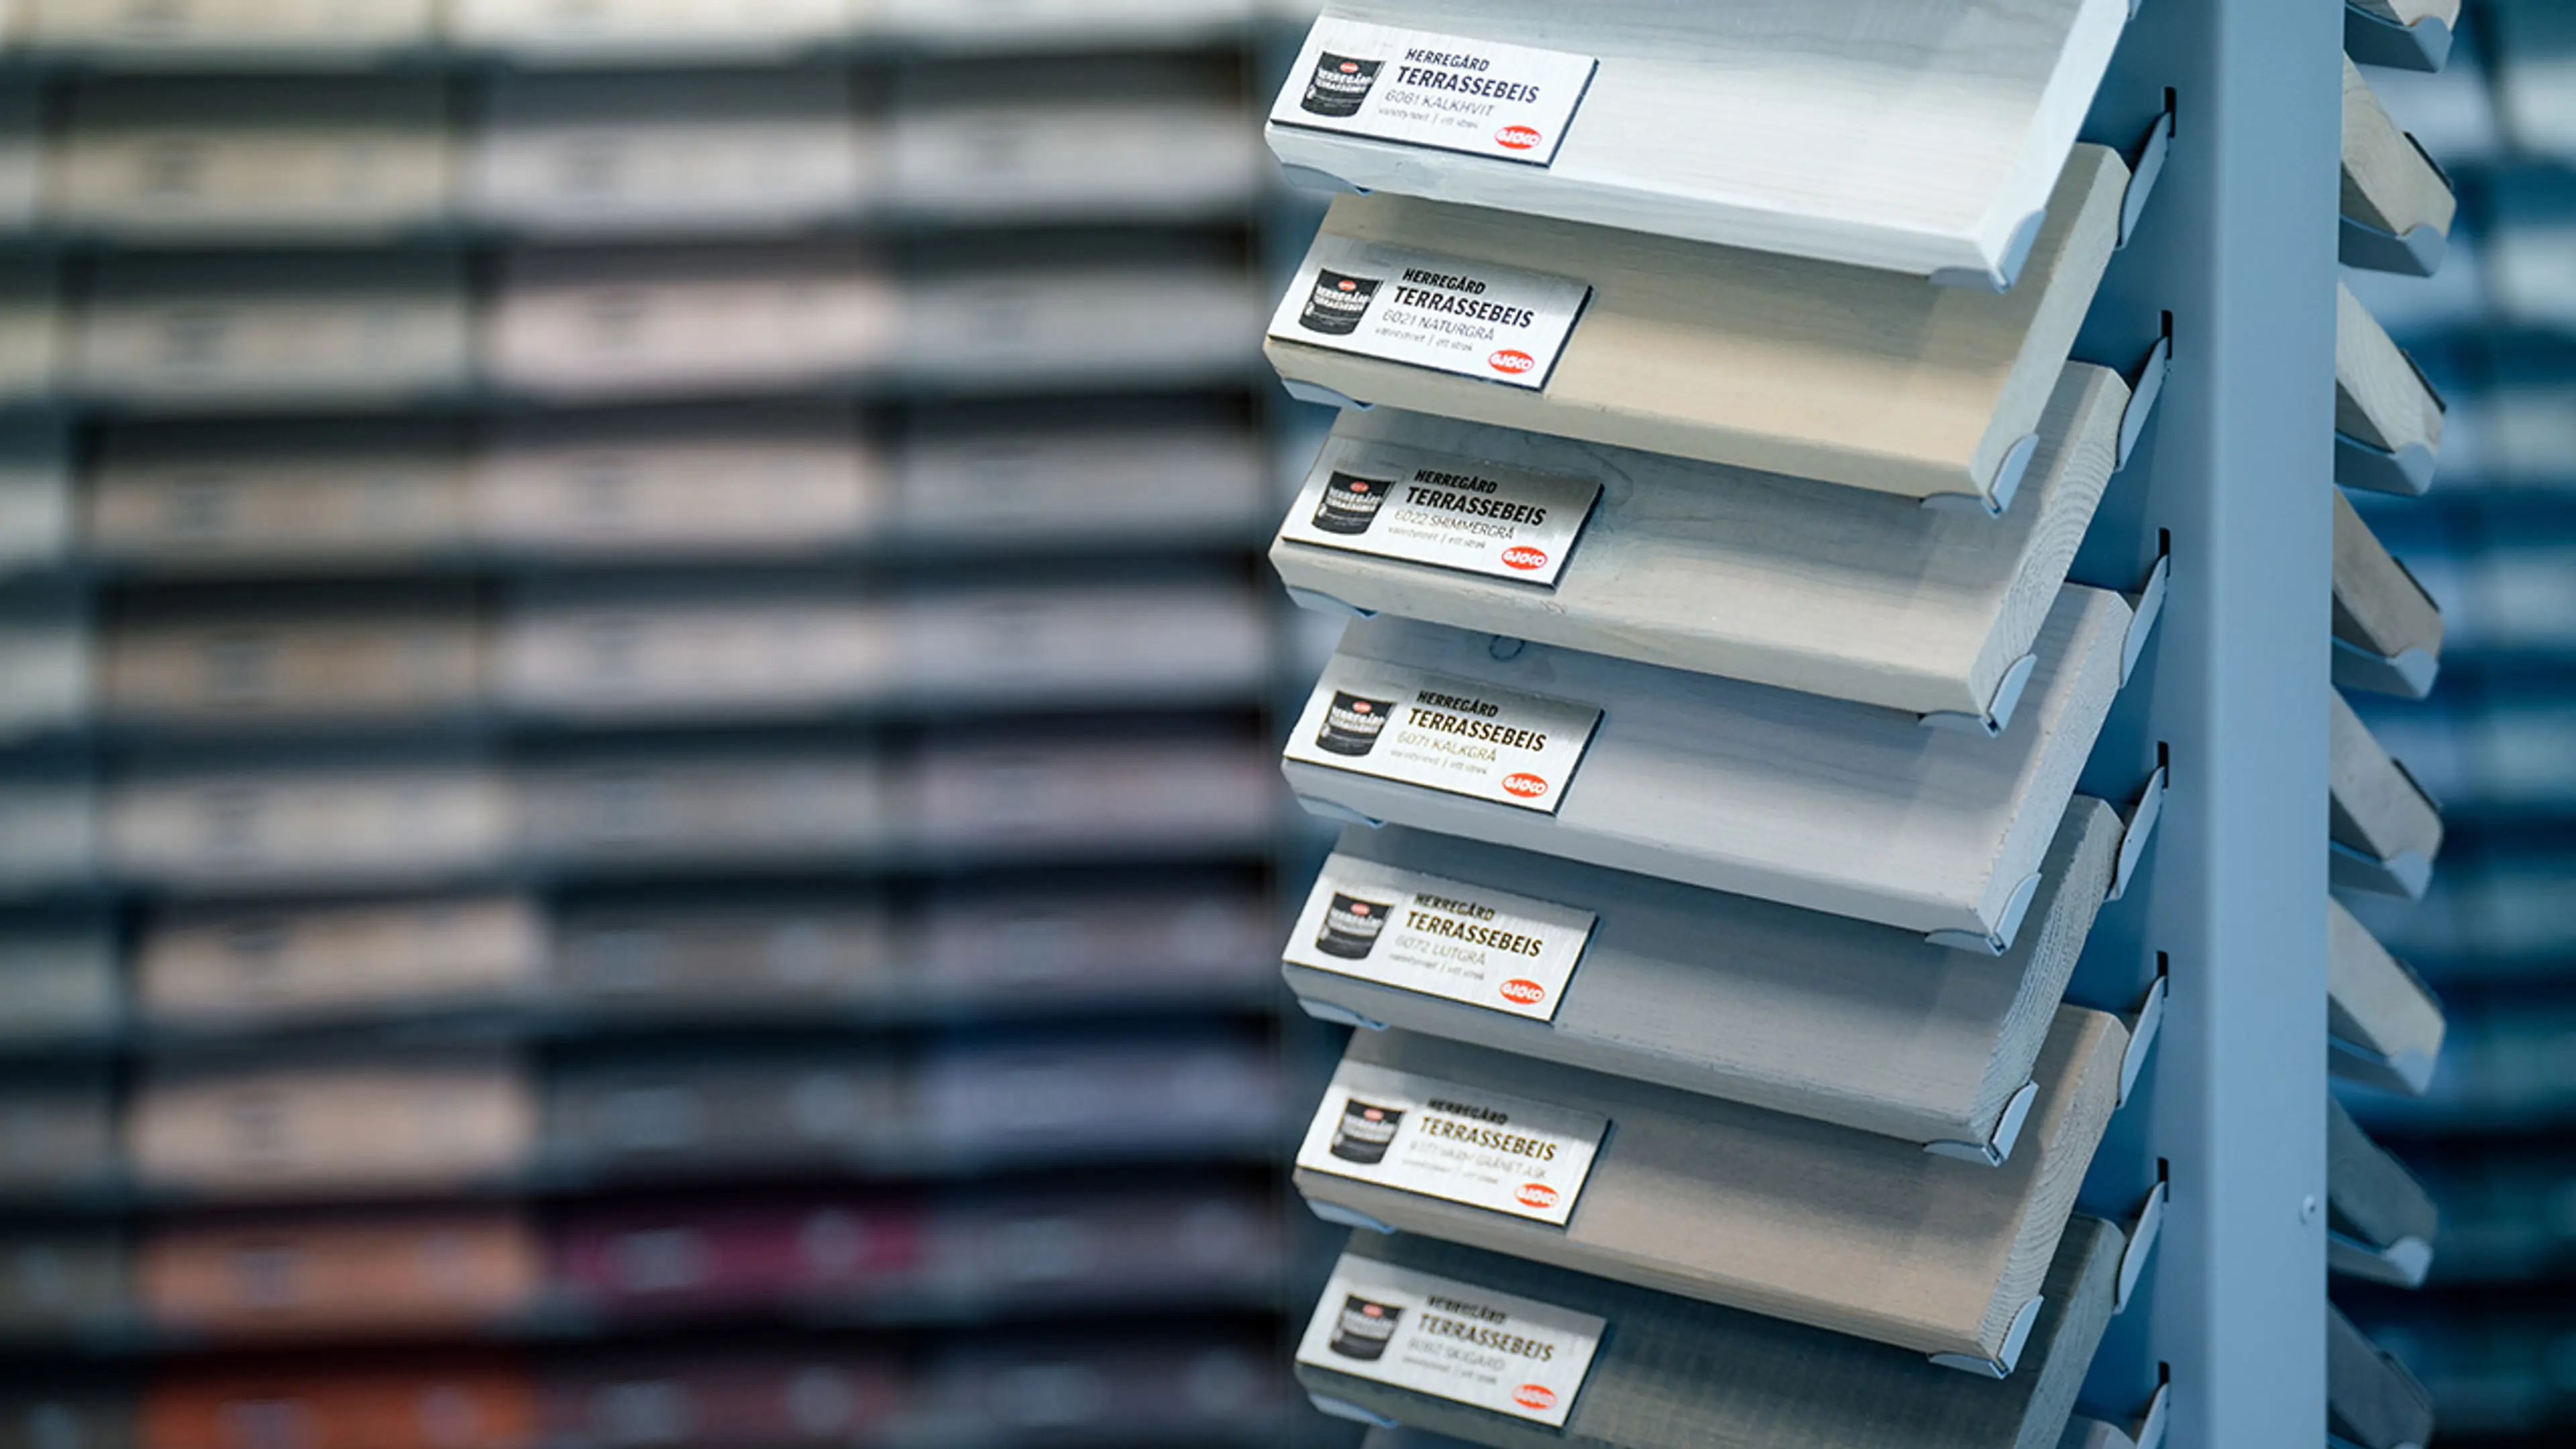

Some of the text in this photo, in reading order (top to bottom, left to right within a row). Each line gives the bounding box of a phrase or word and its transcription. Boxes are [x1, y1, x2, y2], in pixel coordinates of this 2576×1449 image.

[1405, 48, 1491, 72] HERREGÅRD
[1397, 66, 1540, 103] TERRASSEBEIS
[1403, 268, 1487, 295] HERREGÅRD
[1394, 285, 1534, 328] TERRASSEBEIS
[1414, 469, 1497, 494] HERREGÅRD
[1405, 486, 1547, 526] TERRASSEBEIS
[1416, 690, 1499, 718] HERREGÅRD
[1408, 708, 1547, 752] TERRASSEBEIS
[1406, 910, 1543, 957] TERRASSEBEIS
[1419, 1115, 1557, 1161] TERRASSEBEIS
[1419, 1313, 1555, 1362] TERRASSEBEIS
